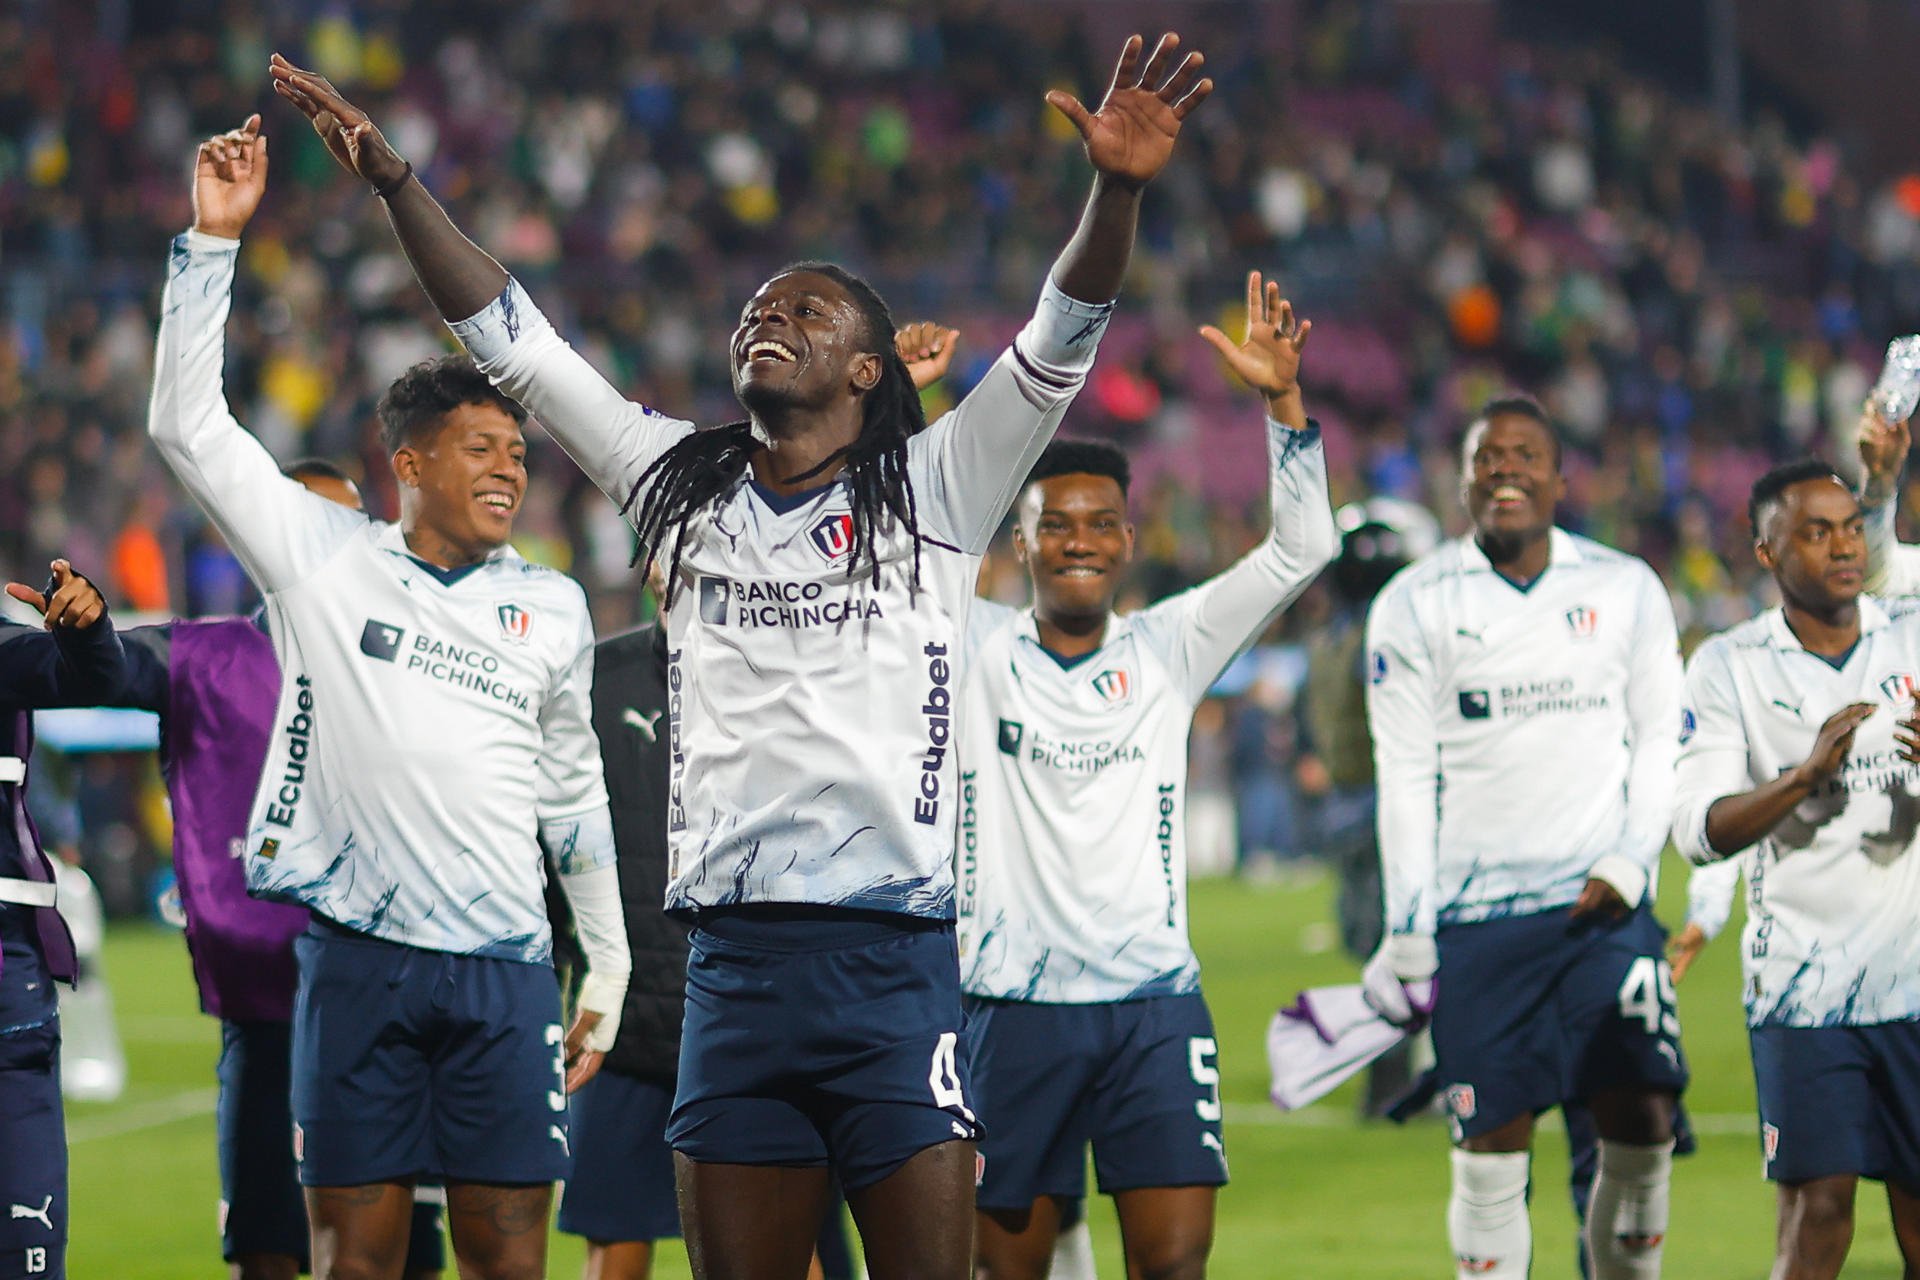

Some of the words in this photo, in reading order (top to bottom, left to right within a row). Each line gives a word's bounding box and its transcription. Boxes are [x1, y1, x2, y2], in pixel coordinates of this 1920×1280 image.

[734, 582, 823, 603] BANCO
[739, 598, 883, 629] PICHINCHA
[407, 654, 530, 713] PICHINCHA
[414, 634, 499, 674] BANCO
[265, 673, 314, 829] Ecuabet
[914, 641, 950, 826] Ecuabet
[1032, 746, 1146, 773] PICHINHA
[1034, 731, 1111, 756] NCO
[1842, 749, 1902, 771] ANCO
[961, 769, 978, 918] Ecuabet
[1158, 783, 1177, 928] abet
[544, 1025, 566, 1112] 3
[929, 1032, 975, 1123] 4
[1189, 1037, 1221, 1121] 5
[26, 1247, 46, 1273] 13
